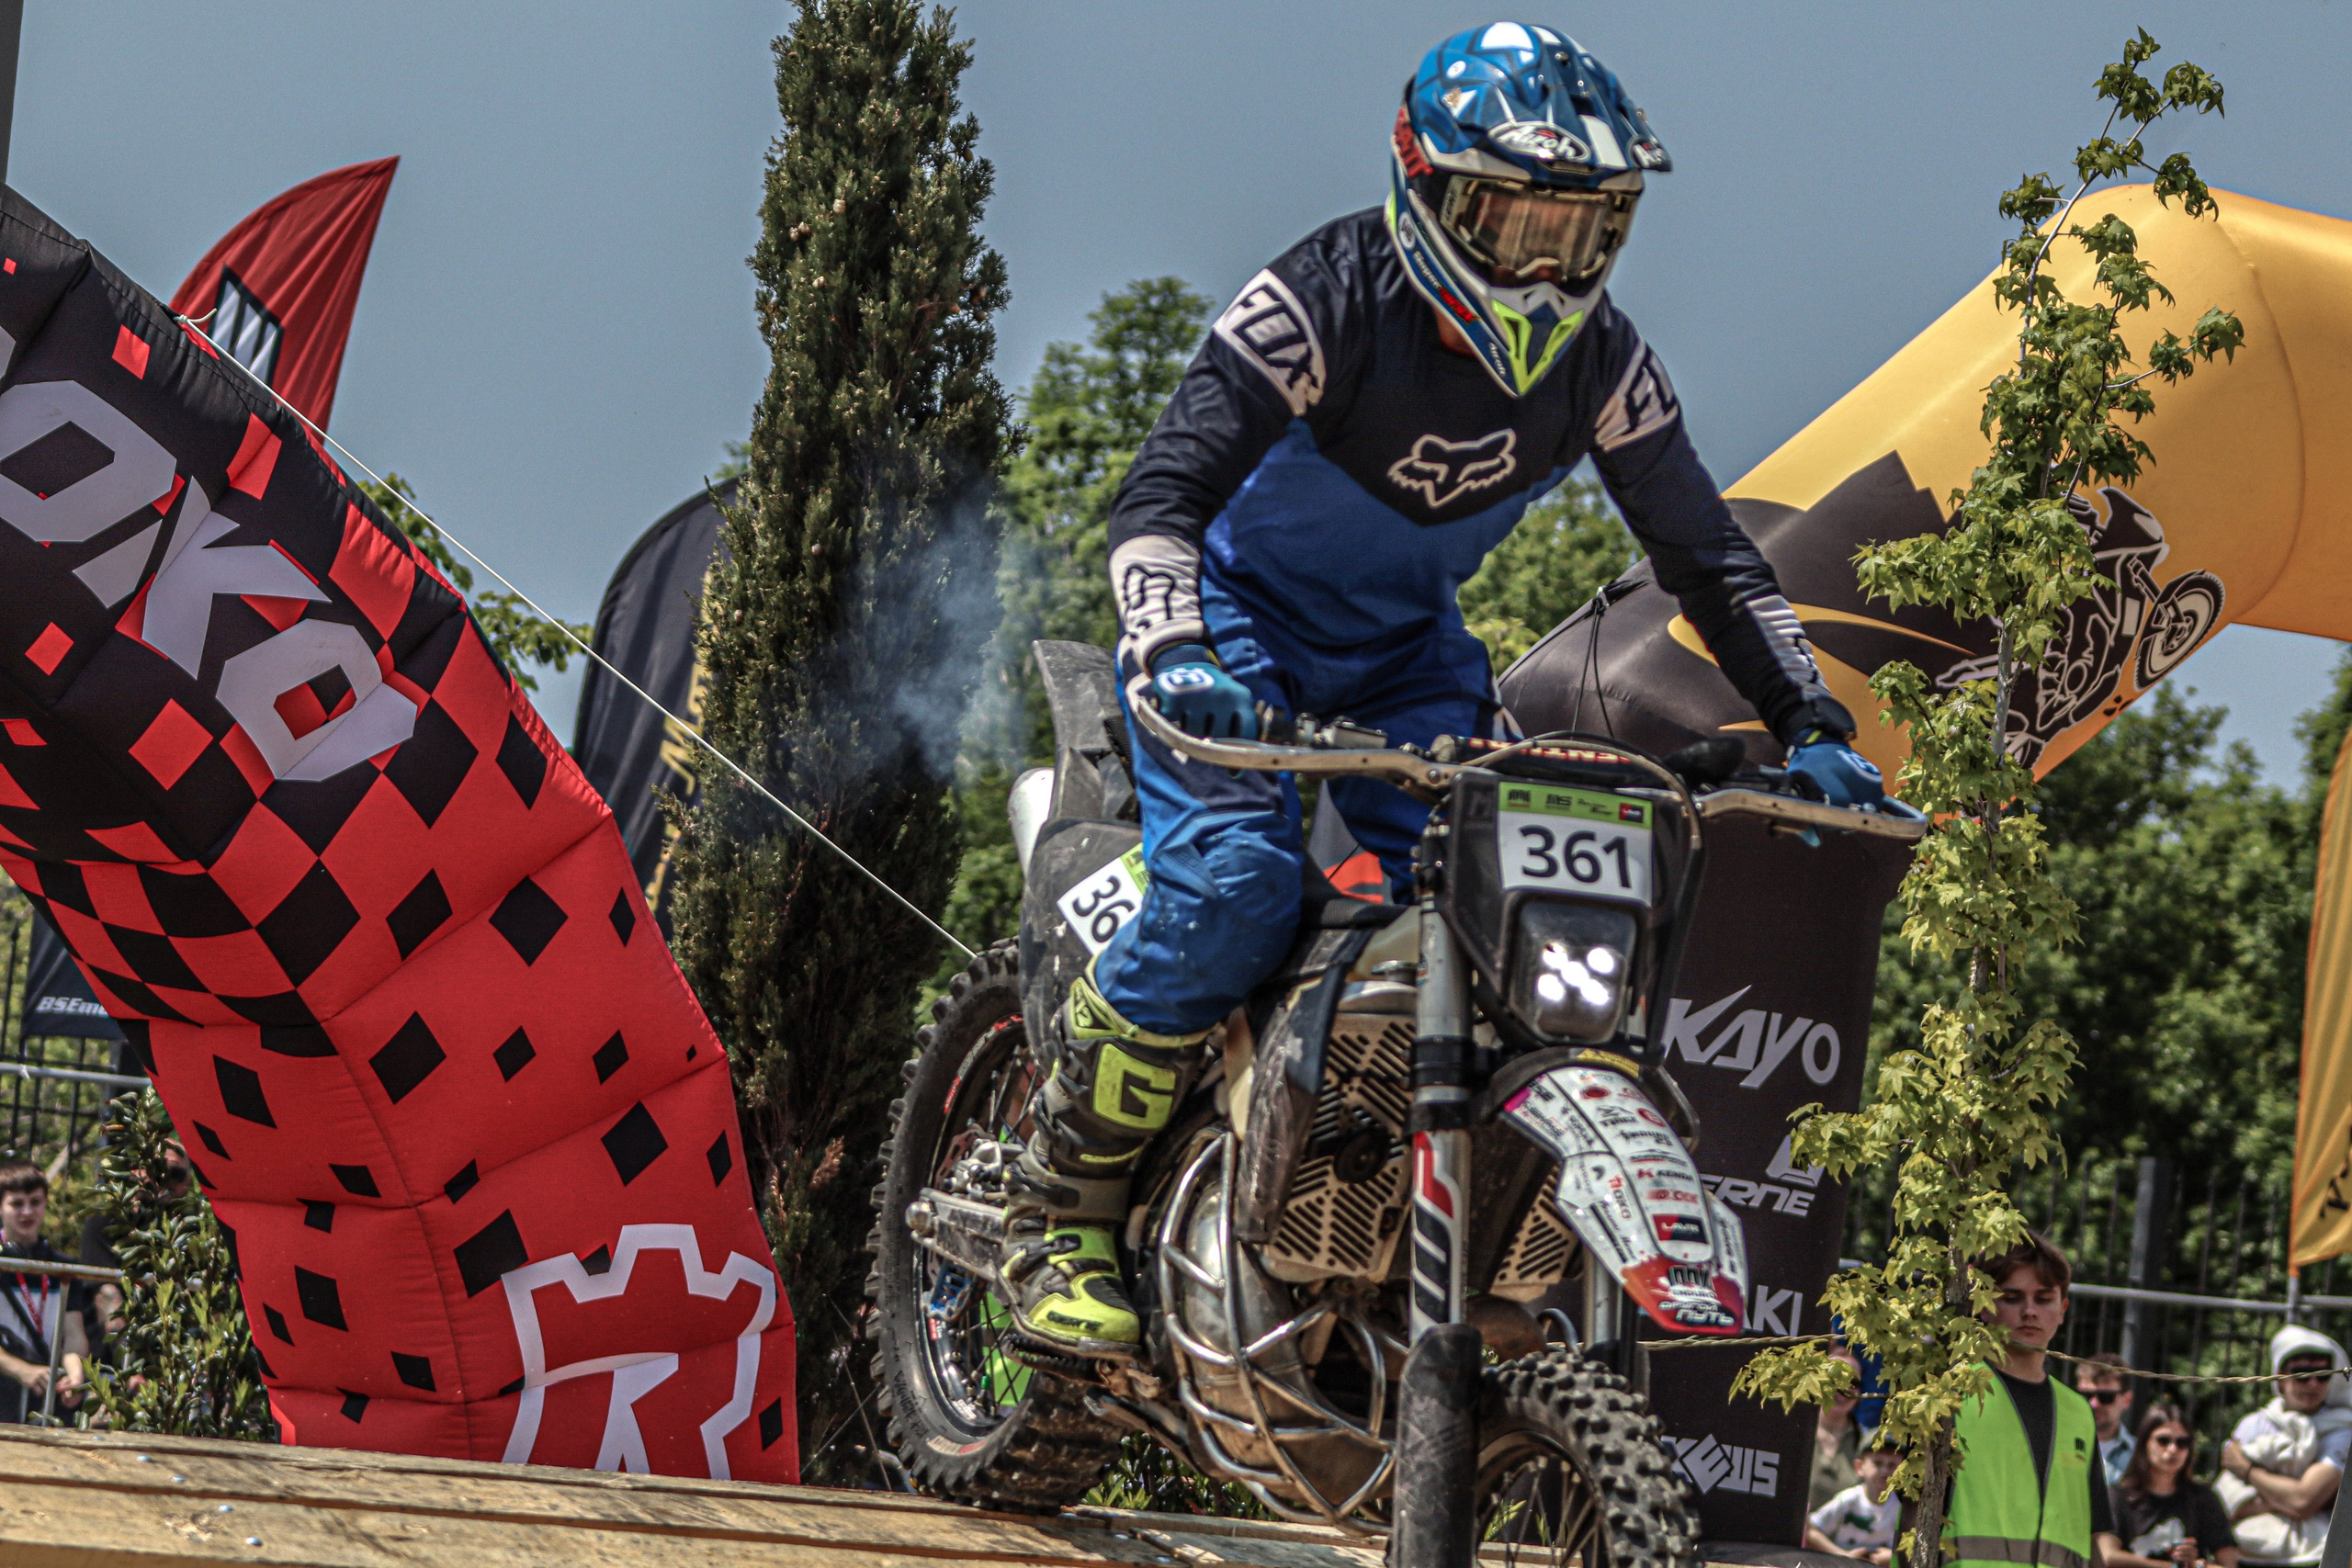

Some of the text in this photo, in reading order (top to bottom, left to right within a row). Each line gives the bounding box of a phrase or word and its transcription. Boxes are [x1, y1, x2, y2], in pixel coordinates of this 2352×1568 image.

[1497, 125, 1577, 160] Airoh
[1519, 824, 1633, 889] 361
[1071, 875, 1136, 943] 36
[1661, 985, 1840, 1089] KAYO
[1657, 1169, 1694, 1180] KENDA
[1700, 1173, 1815, 1217] ERNE
[1676, 1308, 1735, 1325] ПУТЬ
